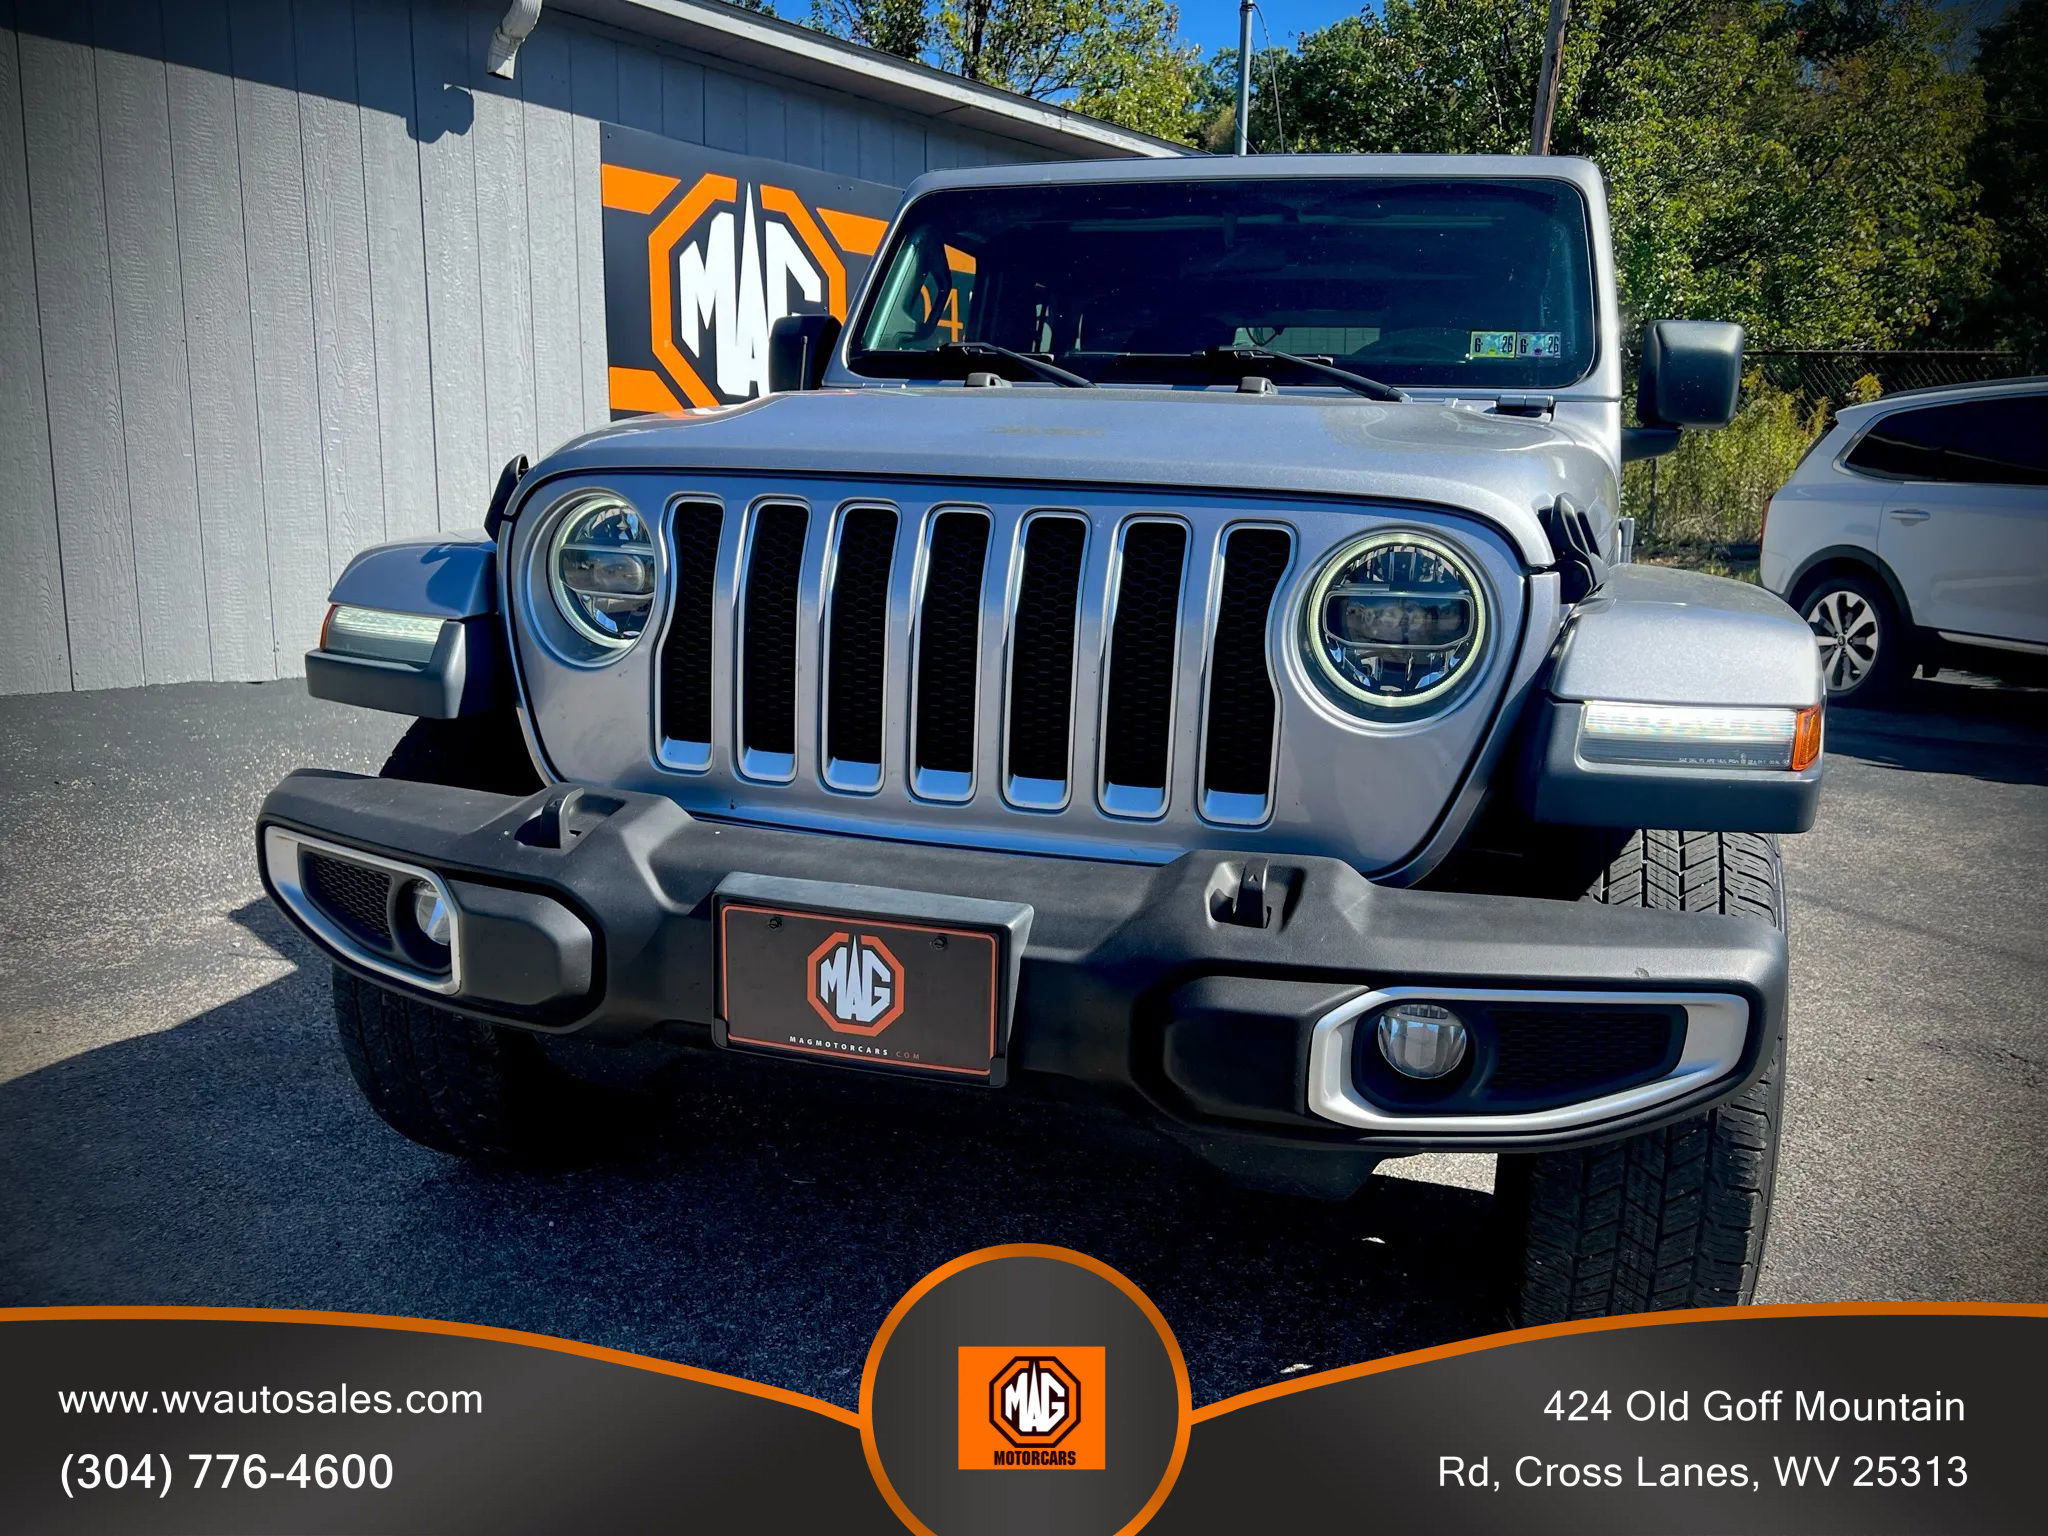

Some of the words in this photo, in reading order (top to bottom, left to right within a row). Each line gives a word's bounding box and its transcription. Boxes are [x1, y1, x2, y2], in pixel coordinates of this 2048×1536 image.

[1502, 335, 1514, 353] 26
[1547, 336, 1559, 353] 26
[820, 934, 891, 1023] MAG
[789, 1035, 888, 1056] MAGMOTORCARS
